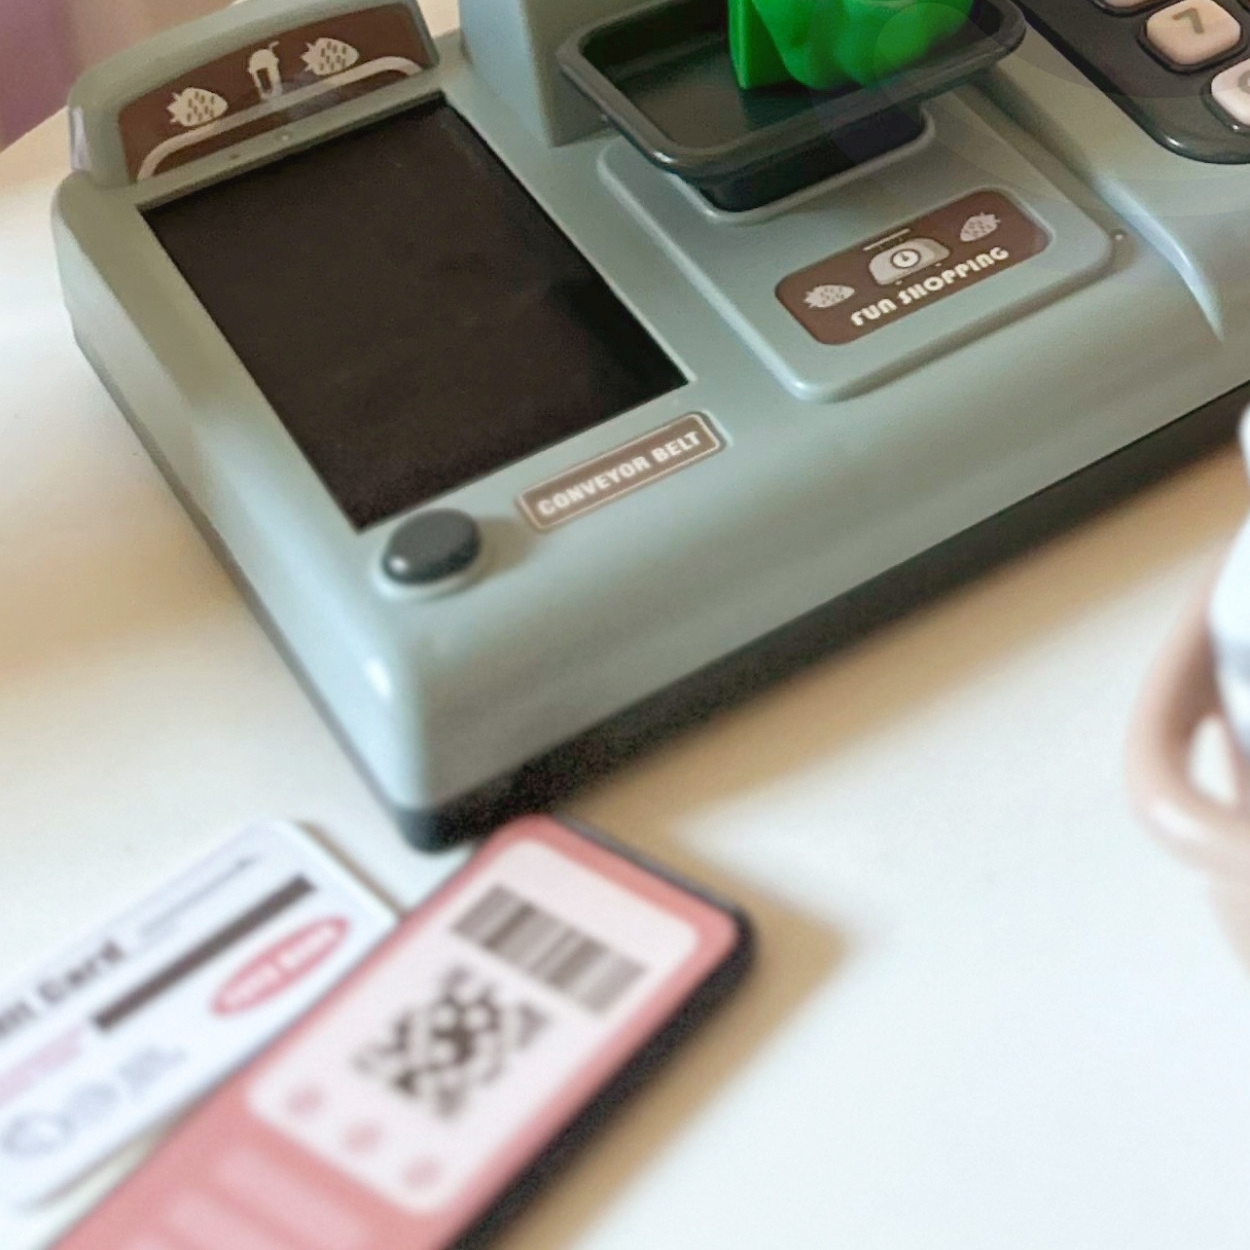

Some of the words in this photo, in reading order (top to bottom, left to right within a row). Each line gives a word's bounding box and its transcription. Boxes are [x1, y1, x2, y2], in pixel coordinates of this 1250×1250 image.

[1171, 7, 1205, 35] 7
[850, 299, 897, 327] FUN
[898, 246, 1010, 305] SHOPPING
[537, 456, 650, 517] CONVEYOR
[651, 431, 701, 464] BELT
